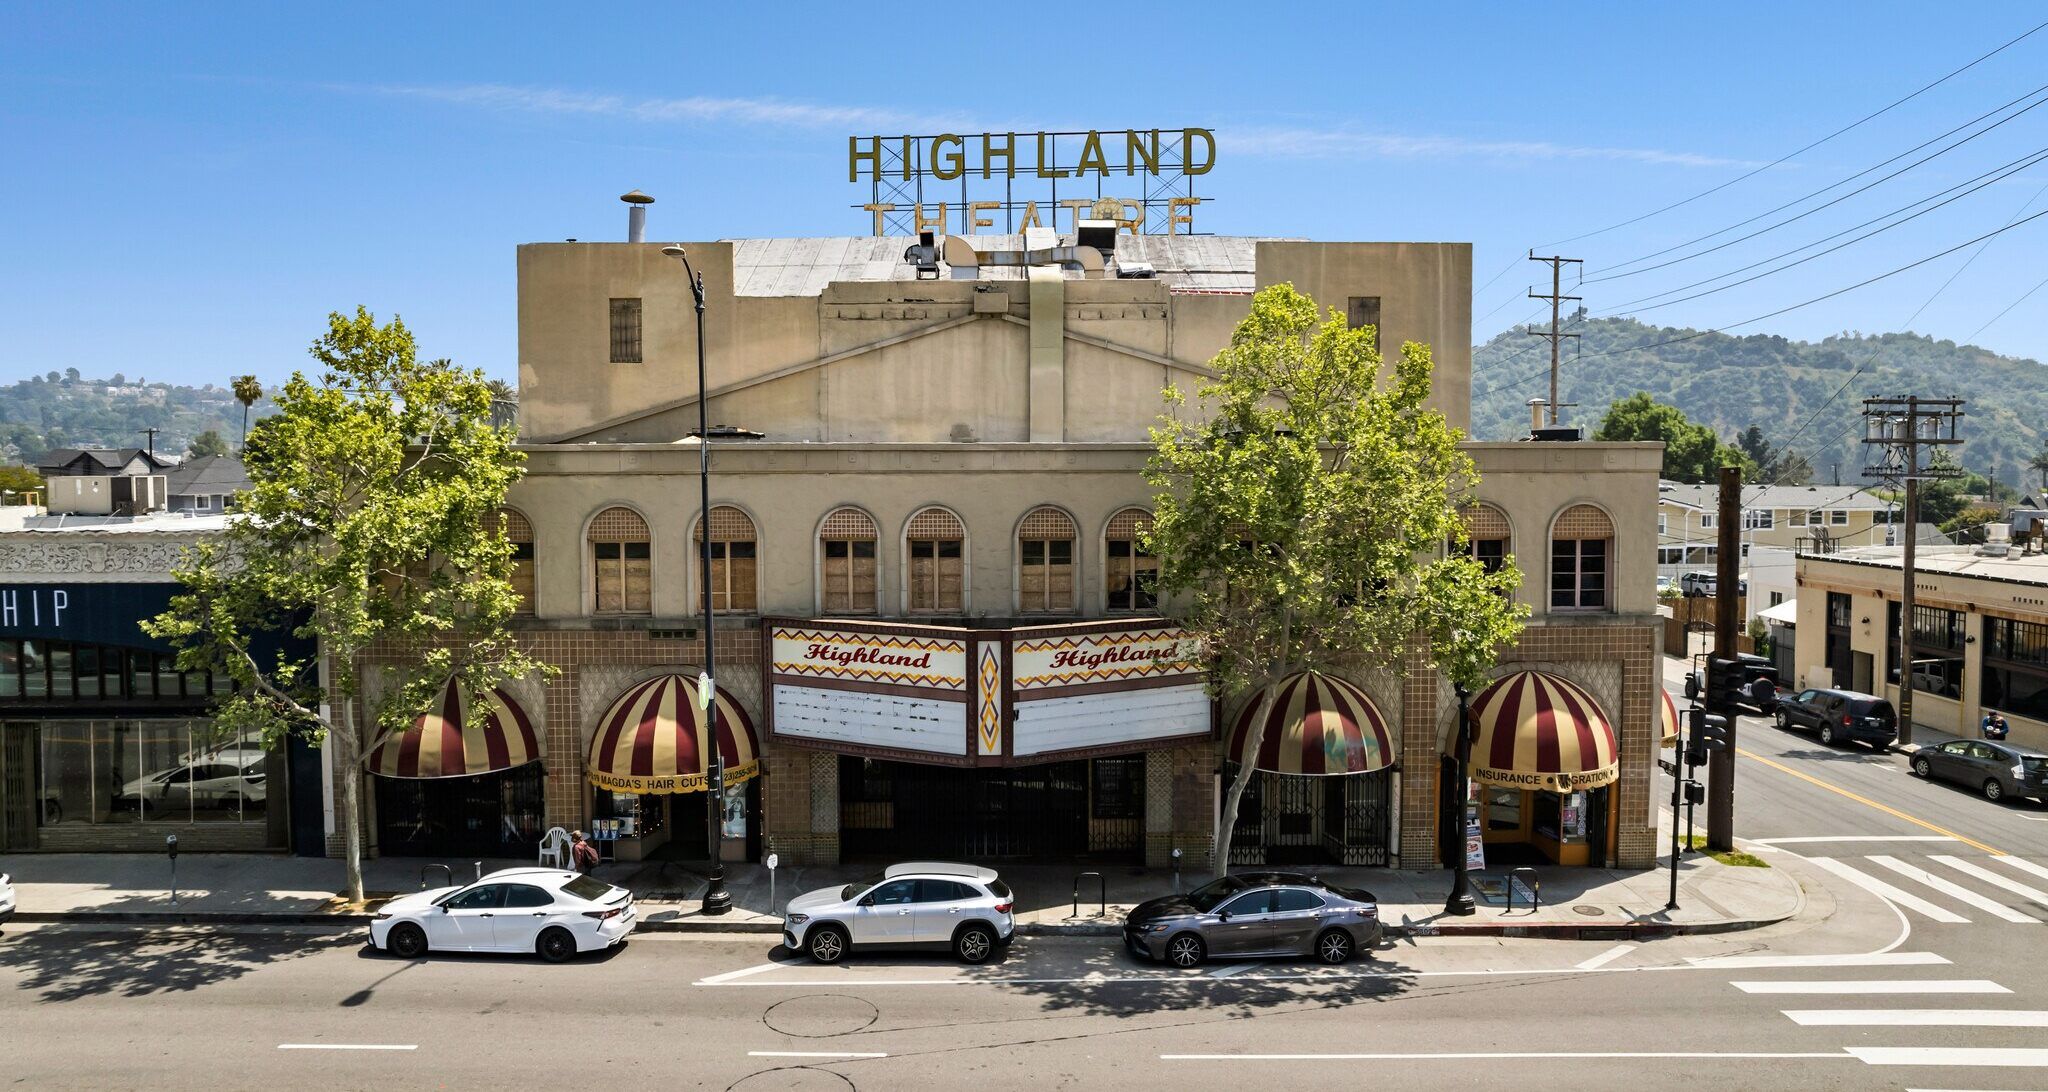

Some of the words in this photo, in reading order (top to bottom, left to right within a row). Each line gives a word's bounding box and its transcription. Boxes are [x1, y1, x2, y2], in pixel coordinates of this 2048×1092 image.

[849, 127, 1216, 183] HIGHLAND
[803, 643, 932, 669] Highland
[1050, 642, 1179, 669] Highland
[600, 775, 642, 789] MAGDA'S
[647, 779, 675, 789] HAIR
[681, 776, 709, 788] CUTS
[1475, 767, 1541, 785] INSURANCE
